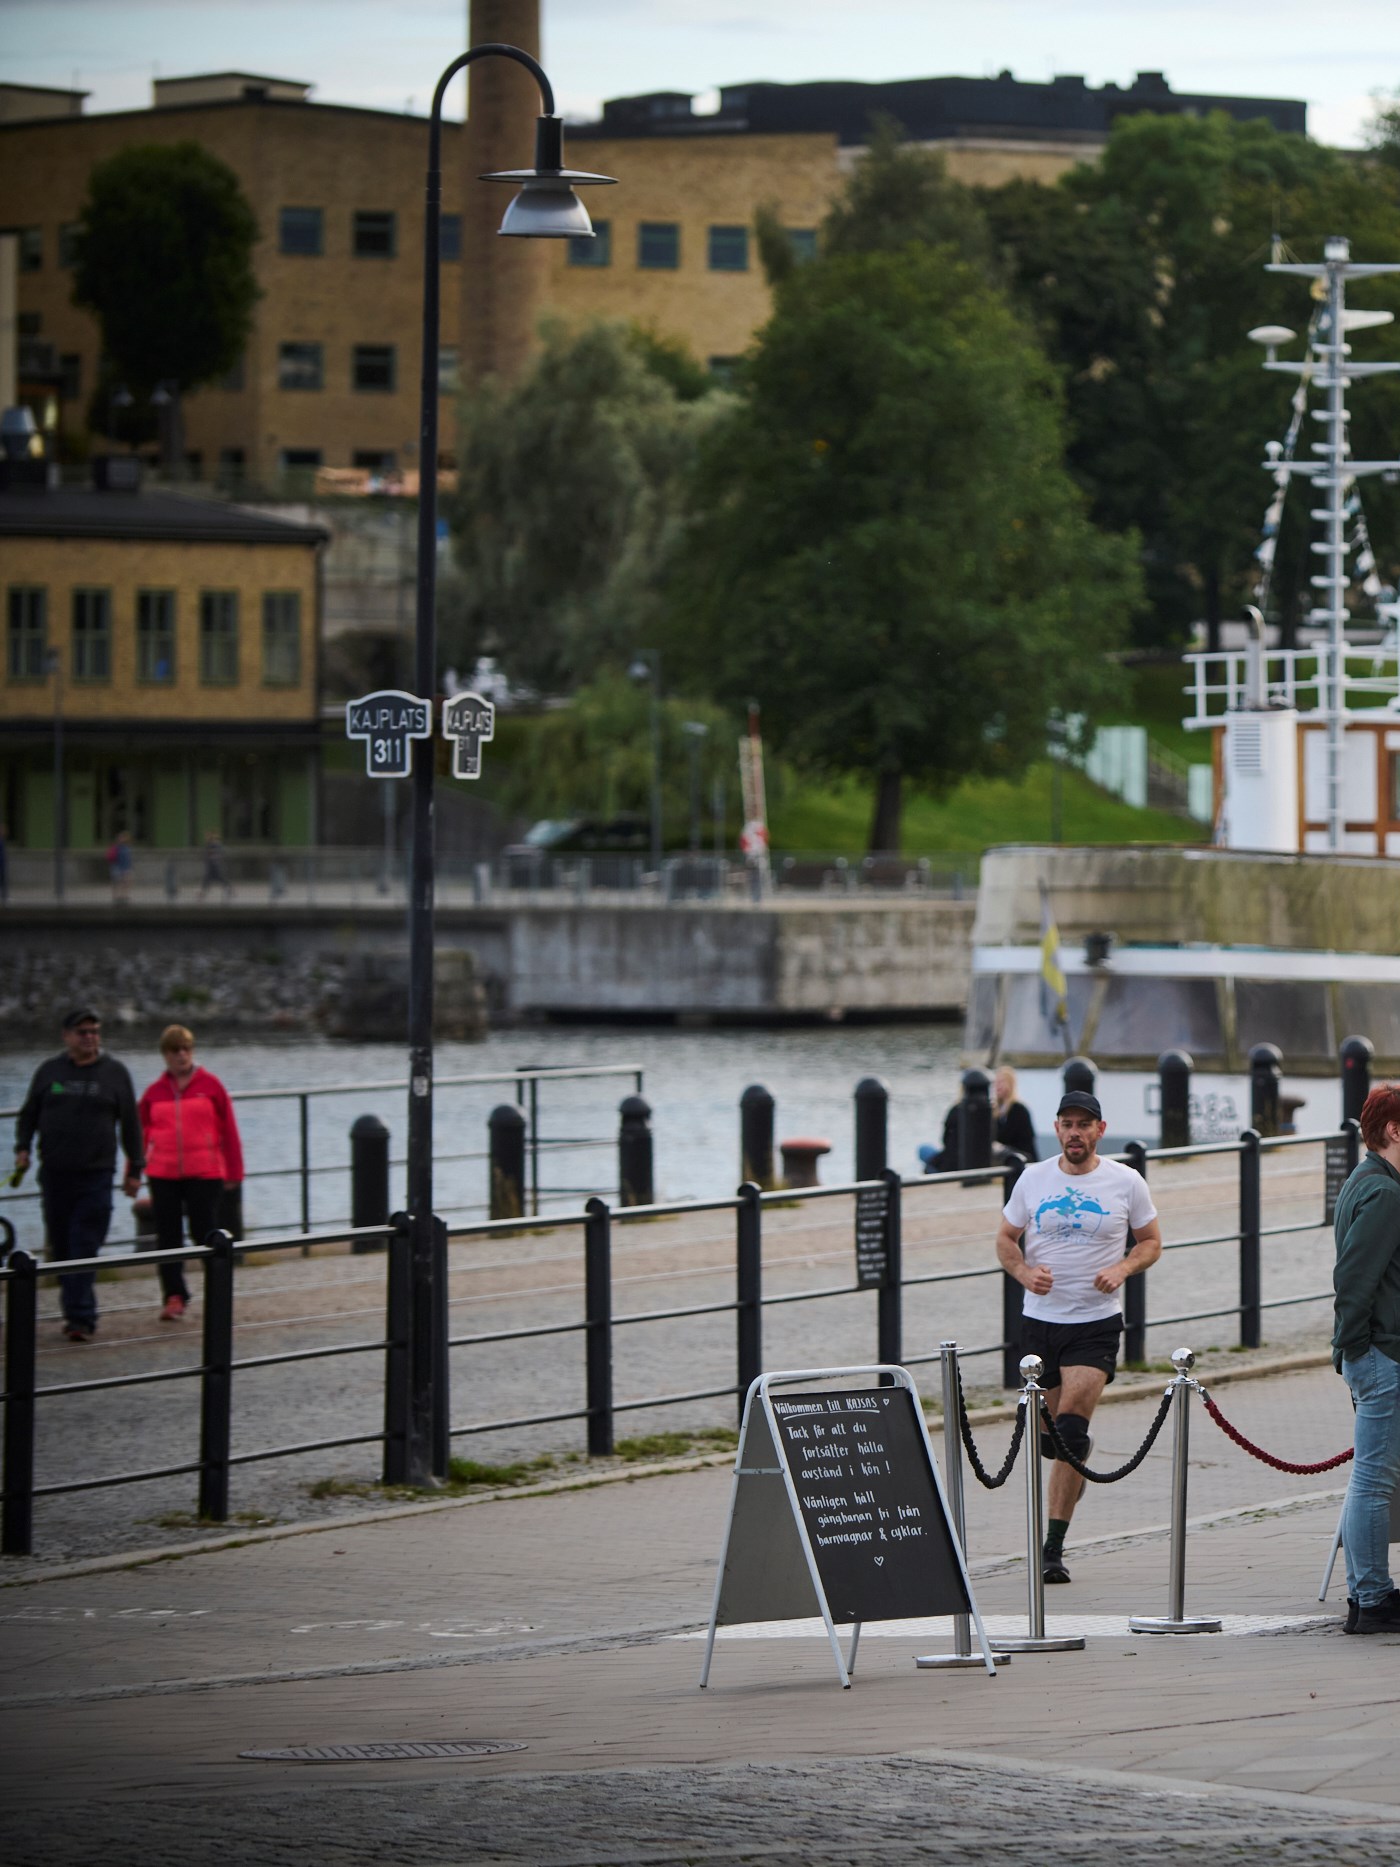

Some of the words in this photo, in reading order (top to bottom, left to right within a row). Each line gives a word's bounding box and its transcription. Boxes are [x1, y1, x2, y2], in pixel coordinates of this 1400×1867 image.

[351, 708, 425, 730] KAJPLATS
[447, 710, 492, 732] KAJPLATS
[374, 737, 401, 763] 311
[773, 1402, 824, 1414] Välkommen
[827, 1399, 842, 1411] till
[845, 1397, 878, 1410] KAJSAS
[786, 1425, 810, 1440] Tack
[813, 1423, 826, 1439] för
[831, 1422, 847, 1435] att
[853, 1421, 867, 1433] du
[802, 1443, 849, 1462] fortsätter
[858, 1440, 884, 1455] hålla
[801, 1465, 843, 1481] avstånd
[849, 1465, 854, 1476] i
[861, 1460, 881, 1476] kön
[803, 1492, 848, 1511] Vänligen
[854, 1490, 876, 1505] håll
[818, 1510, 873, 1528] gångbanan
[878, 1507, 890, 1520] fri
[898, 1504, 921, 1520] från
[816, 1530, 873, 1547] barnvagnar
[879, 1528, 888, 1542] &
